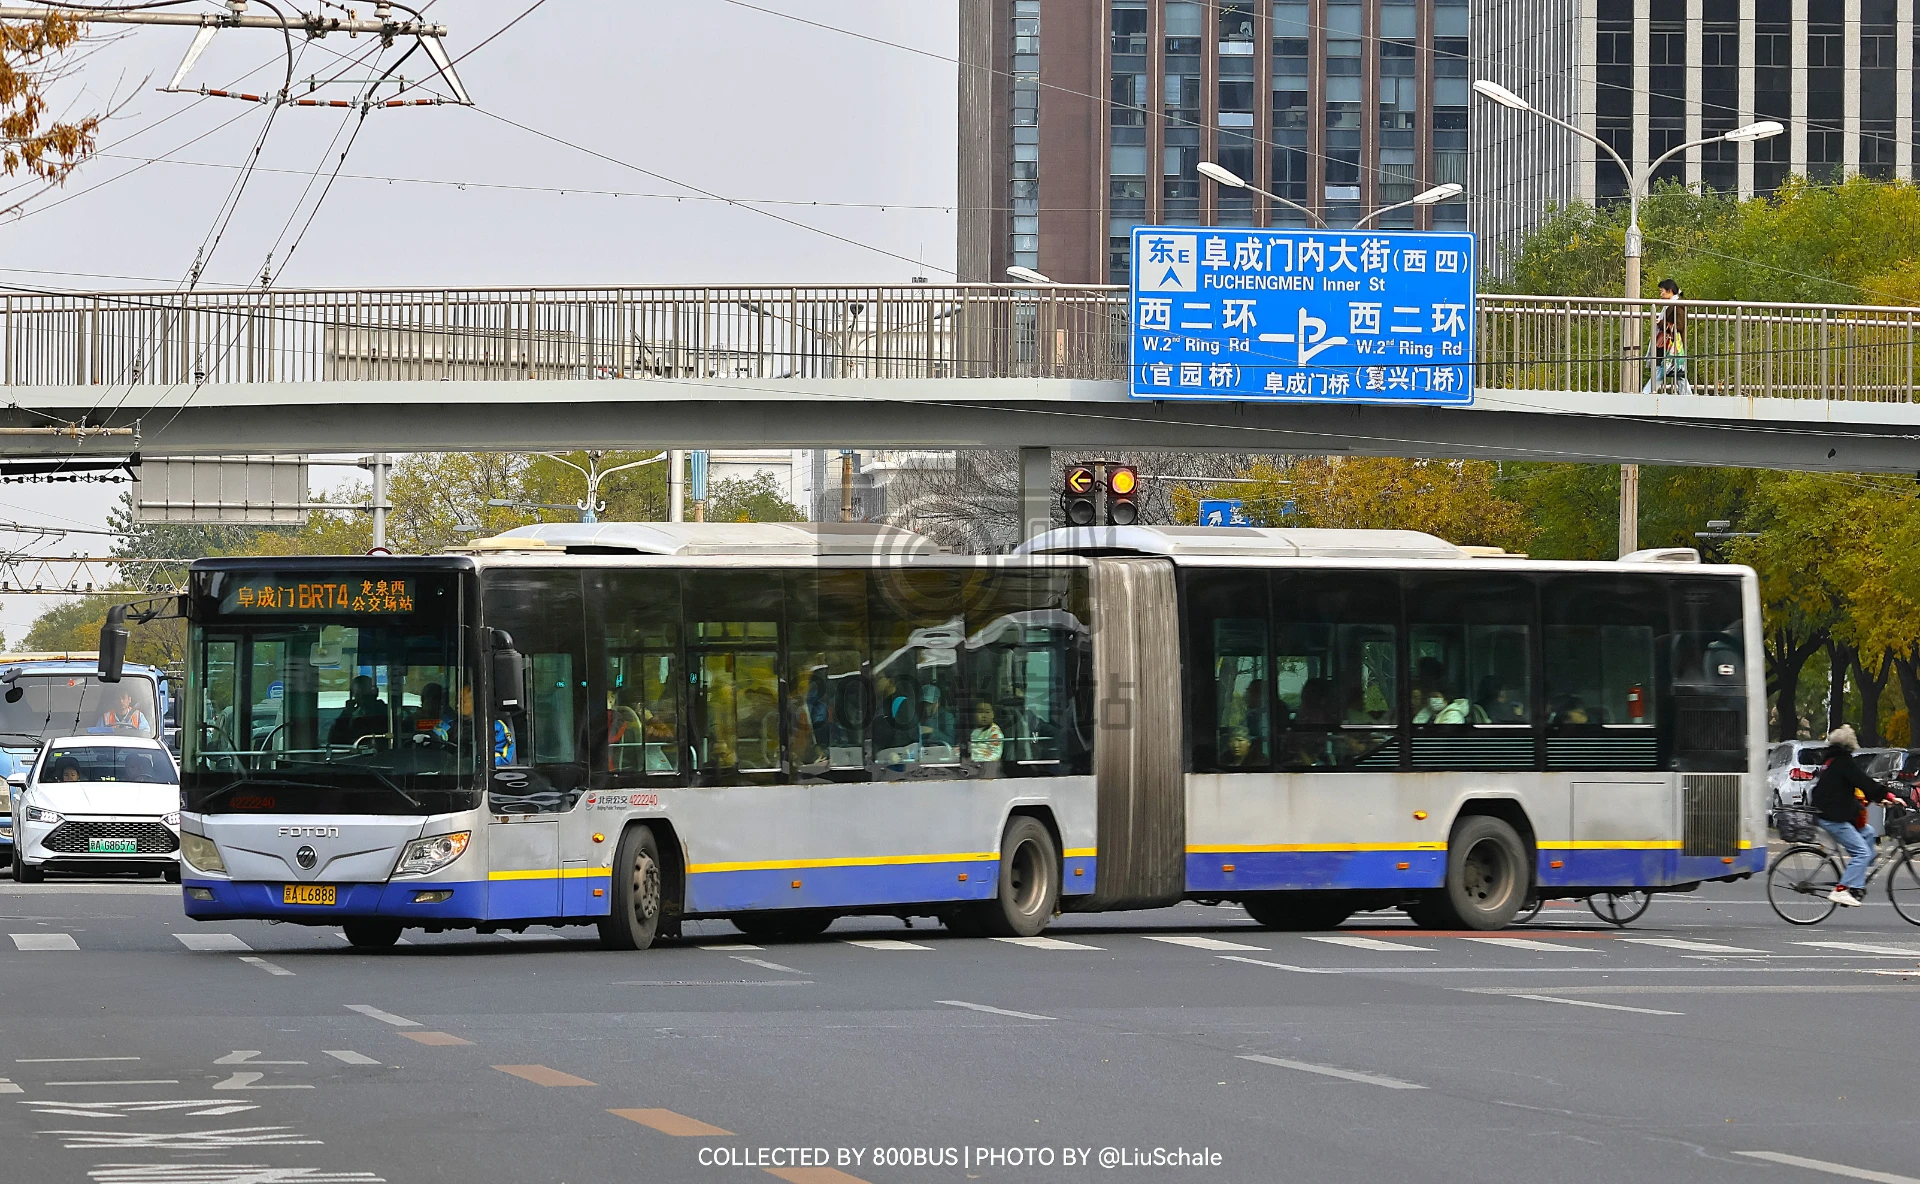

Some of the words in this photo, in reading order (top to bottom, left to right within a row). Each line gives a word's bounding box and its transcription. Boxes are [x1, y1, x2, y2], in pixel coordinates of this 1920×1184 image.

[1148, 236, 1175, 264] 东
[1178, 249, 1190, 264] E
[1203, 273, 1315, 292] FUCHENGMEN
[1323, 276, 1360, 292] Inner
[1368, 276, 1386, 292] St
[1138, 297, 1257, 334] 西二环
[1348, 301, 1466, 338] 西二环
[1184, 337, 1220, 355] Ring
[1228, 337, 1250, 352] Rd
[1399, 340, 1434, 358] Ring
[1441, 340, 1463, 356] Rd
[1264, 371, 1350, 395] 阜成门桥
[236, 585, 296, 608] 阜成门
[298, 583, 349, 609] BRT4
[360, 579, 406, 596] 龙泉西
[351, 596, 413, 613] 公交场站
[229, 796, 276, 809] 4222240
[598, 795, 628, 804] 北京公交
[629, 794, 658, 806] 4222240
[278, 826, 339, 838] FOTON
